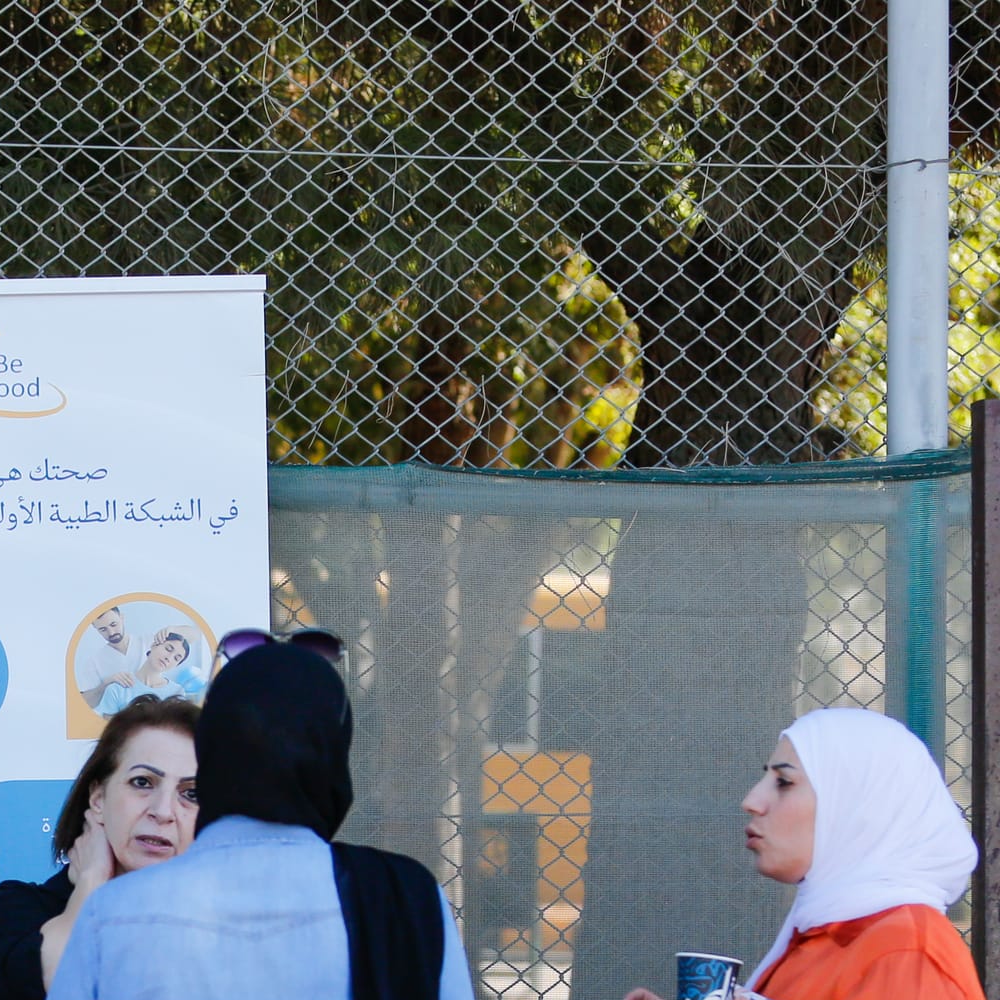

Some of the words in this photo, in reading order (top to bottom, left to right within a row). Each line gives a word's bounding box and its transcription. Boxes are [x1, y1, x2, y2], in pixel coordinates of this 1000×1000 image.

[28, 458, 108, 484] صحتك
[48, 498, 117, 530] الطبية
[123, 497, 201, 528] الشبكة
[208, 497, 239, 535] في
